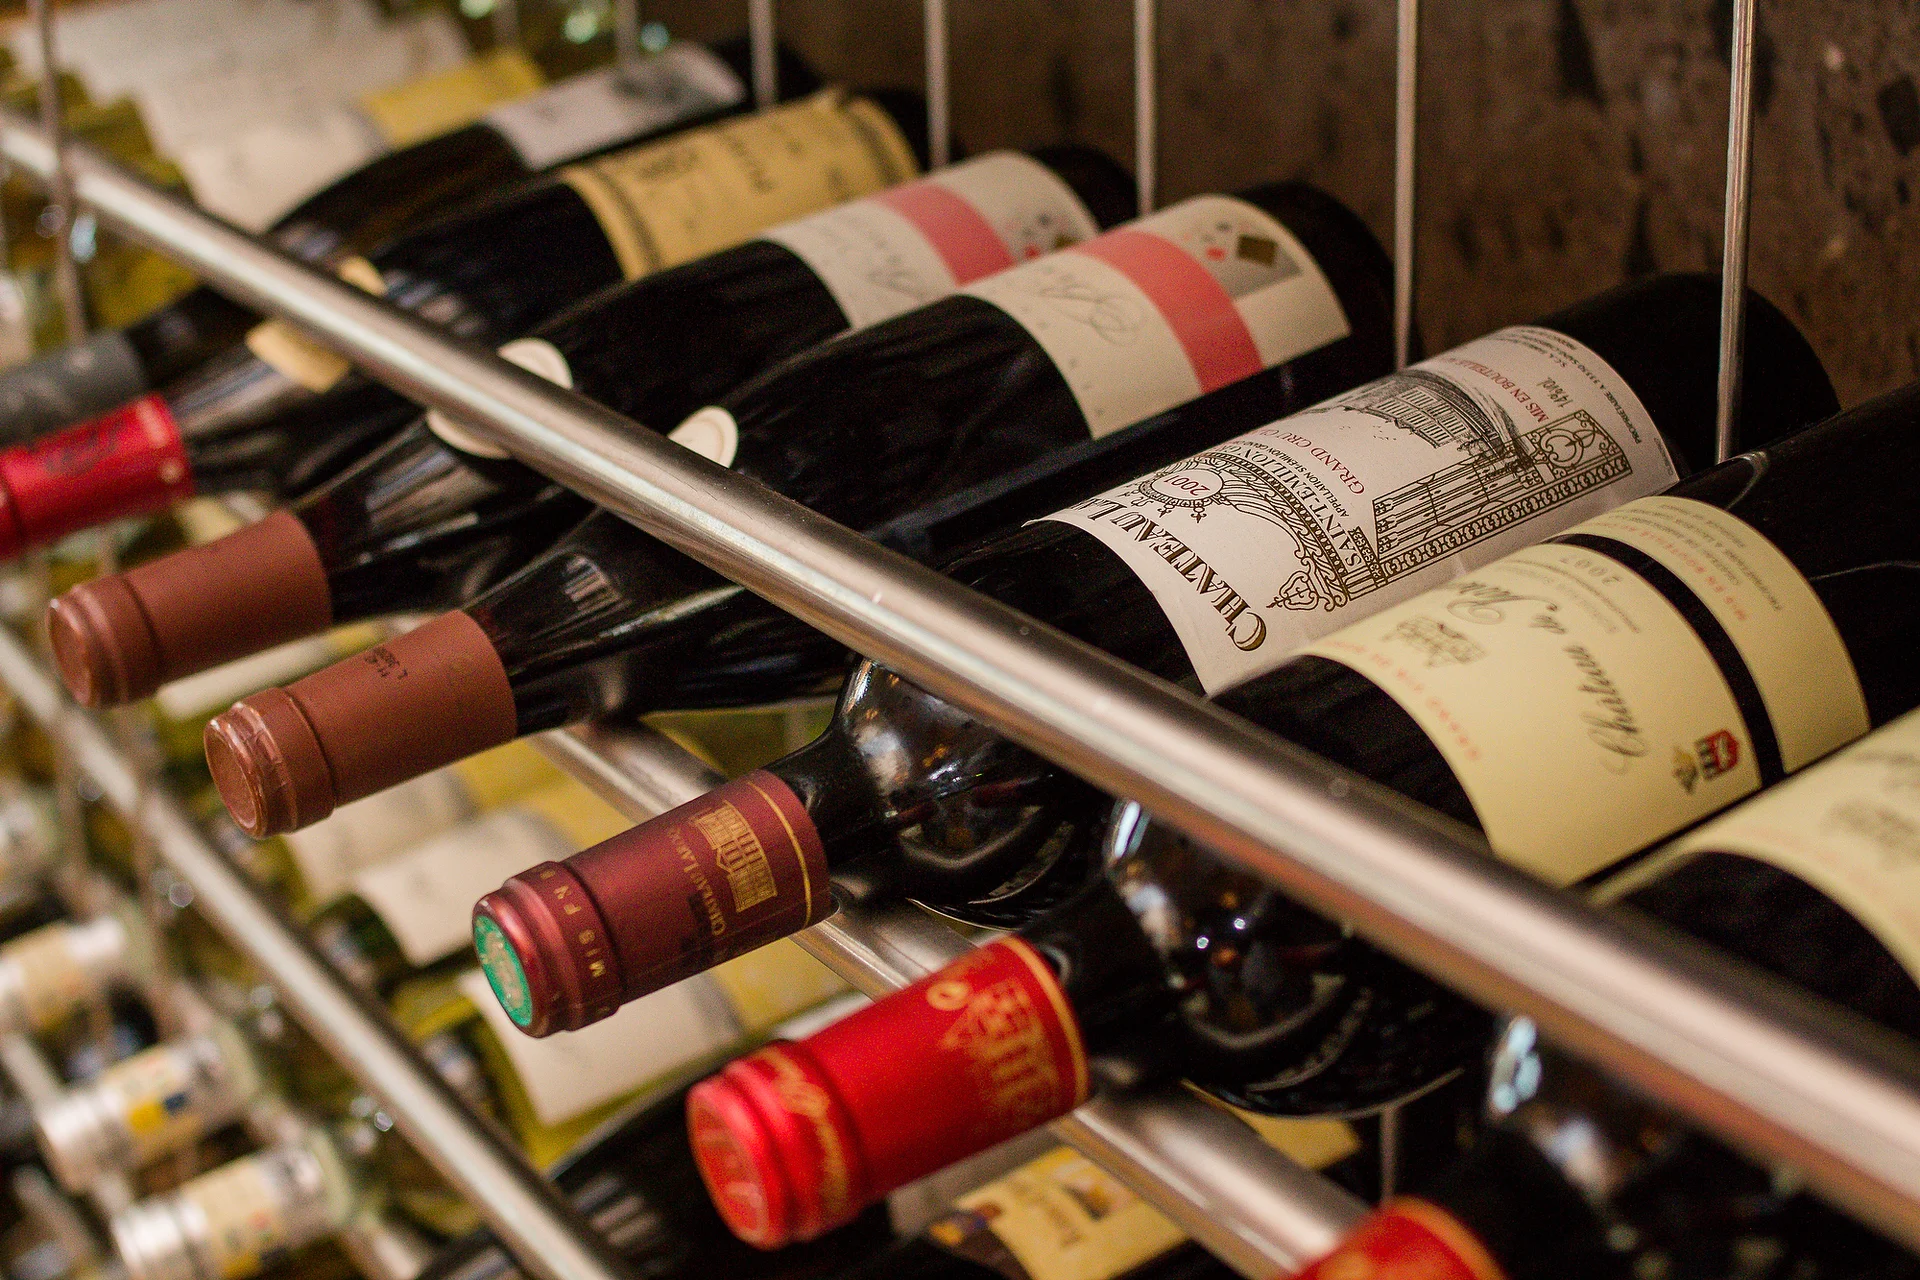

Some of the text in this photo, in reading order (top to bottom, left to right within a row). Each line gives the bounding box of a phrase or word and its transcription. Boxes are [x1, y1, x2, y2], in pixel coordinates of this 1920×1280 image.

[1511, 387, 1531, 404] EN
[1525, 404, 1549, 423] MIS
[1277, 432, 1312, 448] CRU
[1166, 474, 1211, 496] 2001
[1310, 446, 1365, 495] GRAND
[1238, 448, 1362, 567] SAINT-EMILION
[1304, 471, 1349, 517] APPELLATION
[1109, 511, 1267, 651] CHATEAU
